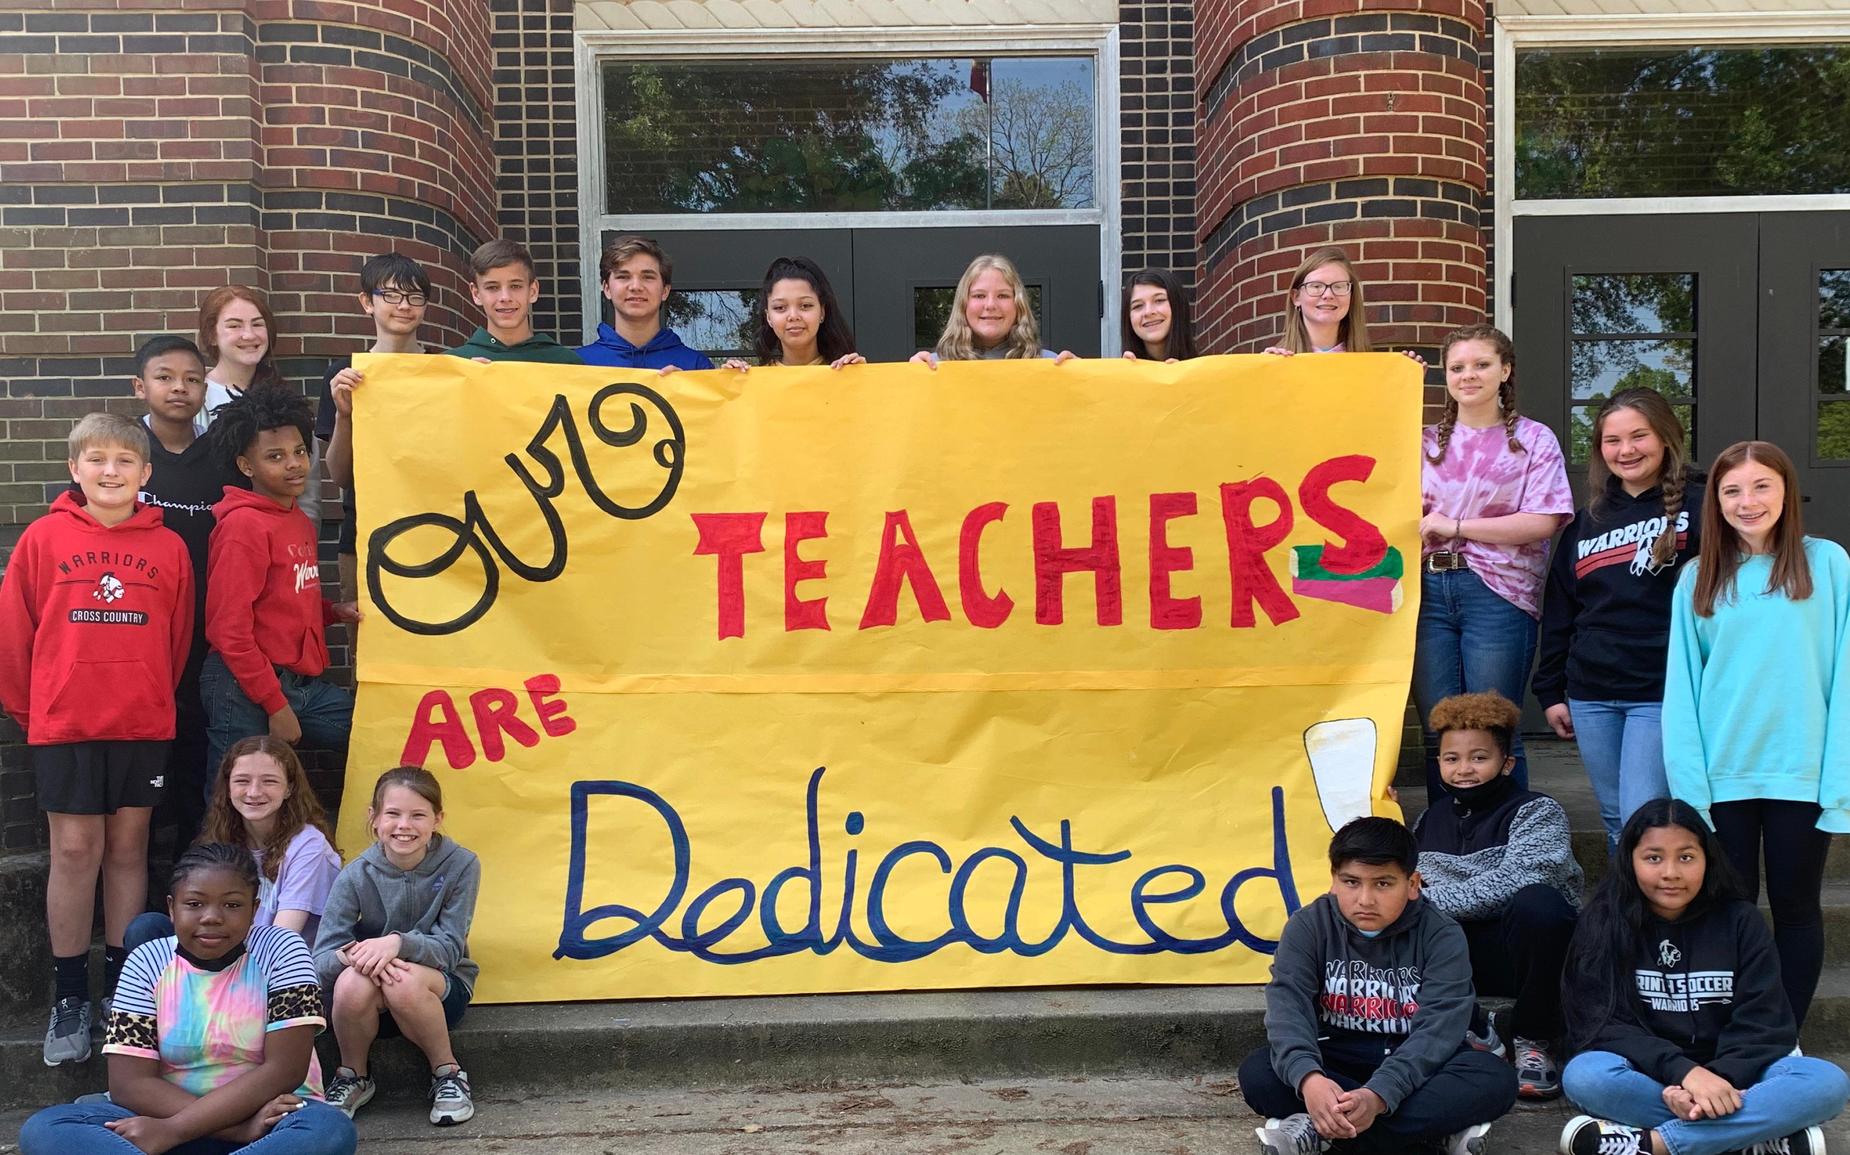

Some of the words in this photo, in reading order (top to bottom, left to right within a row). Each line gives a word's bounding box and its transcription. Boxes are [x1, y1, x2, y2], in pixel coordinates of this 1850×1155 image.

[137, 491, 214, 517] Champio
[690, 454, 1388, 641] TEACHERS
[58, 551, 159, 579] WARRIORS
[72, 610, 100, 622] CROSS
[103, 611, 144, 624] COUNTRY
[400, 673, 577, 769] ARE
[1676, 977, 1734, 993] SOCCER
